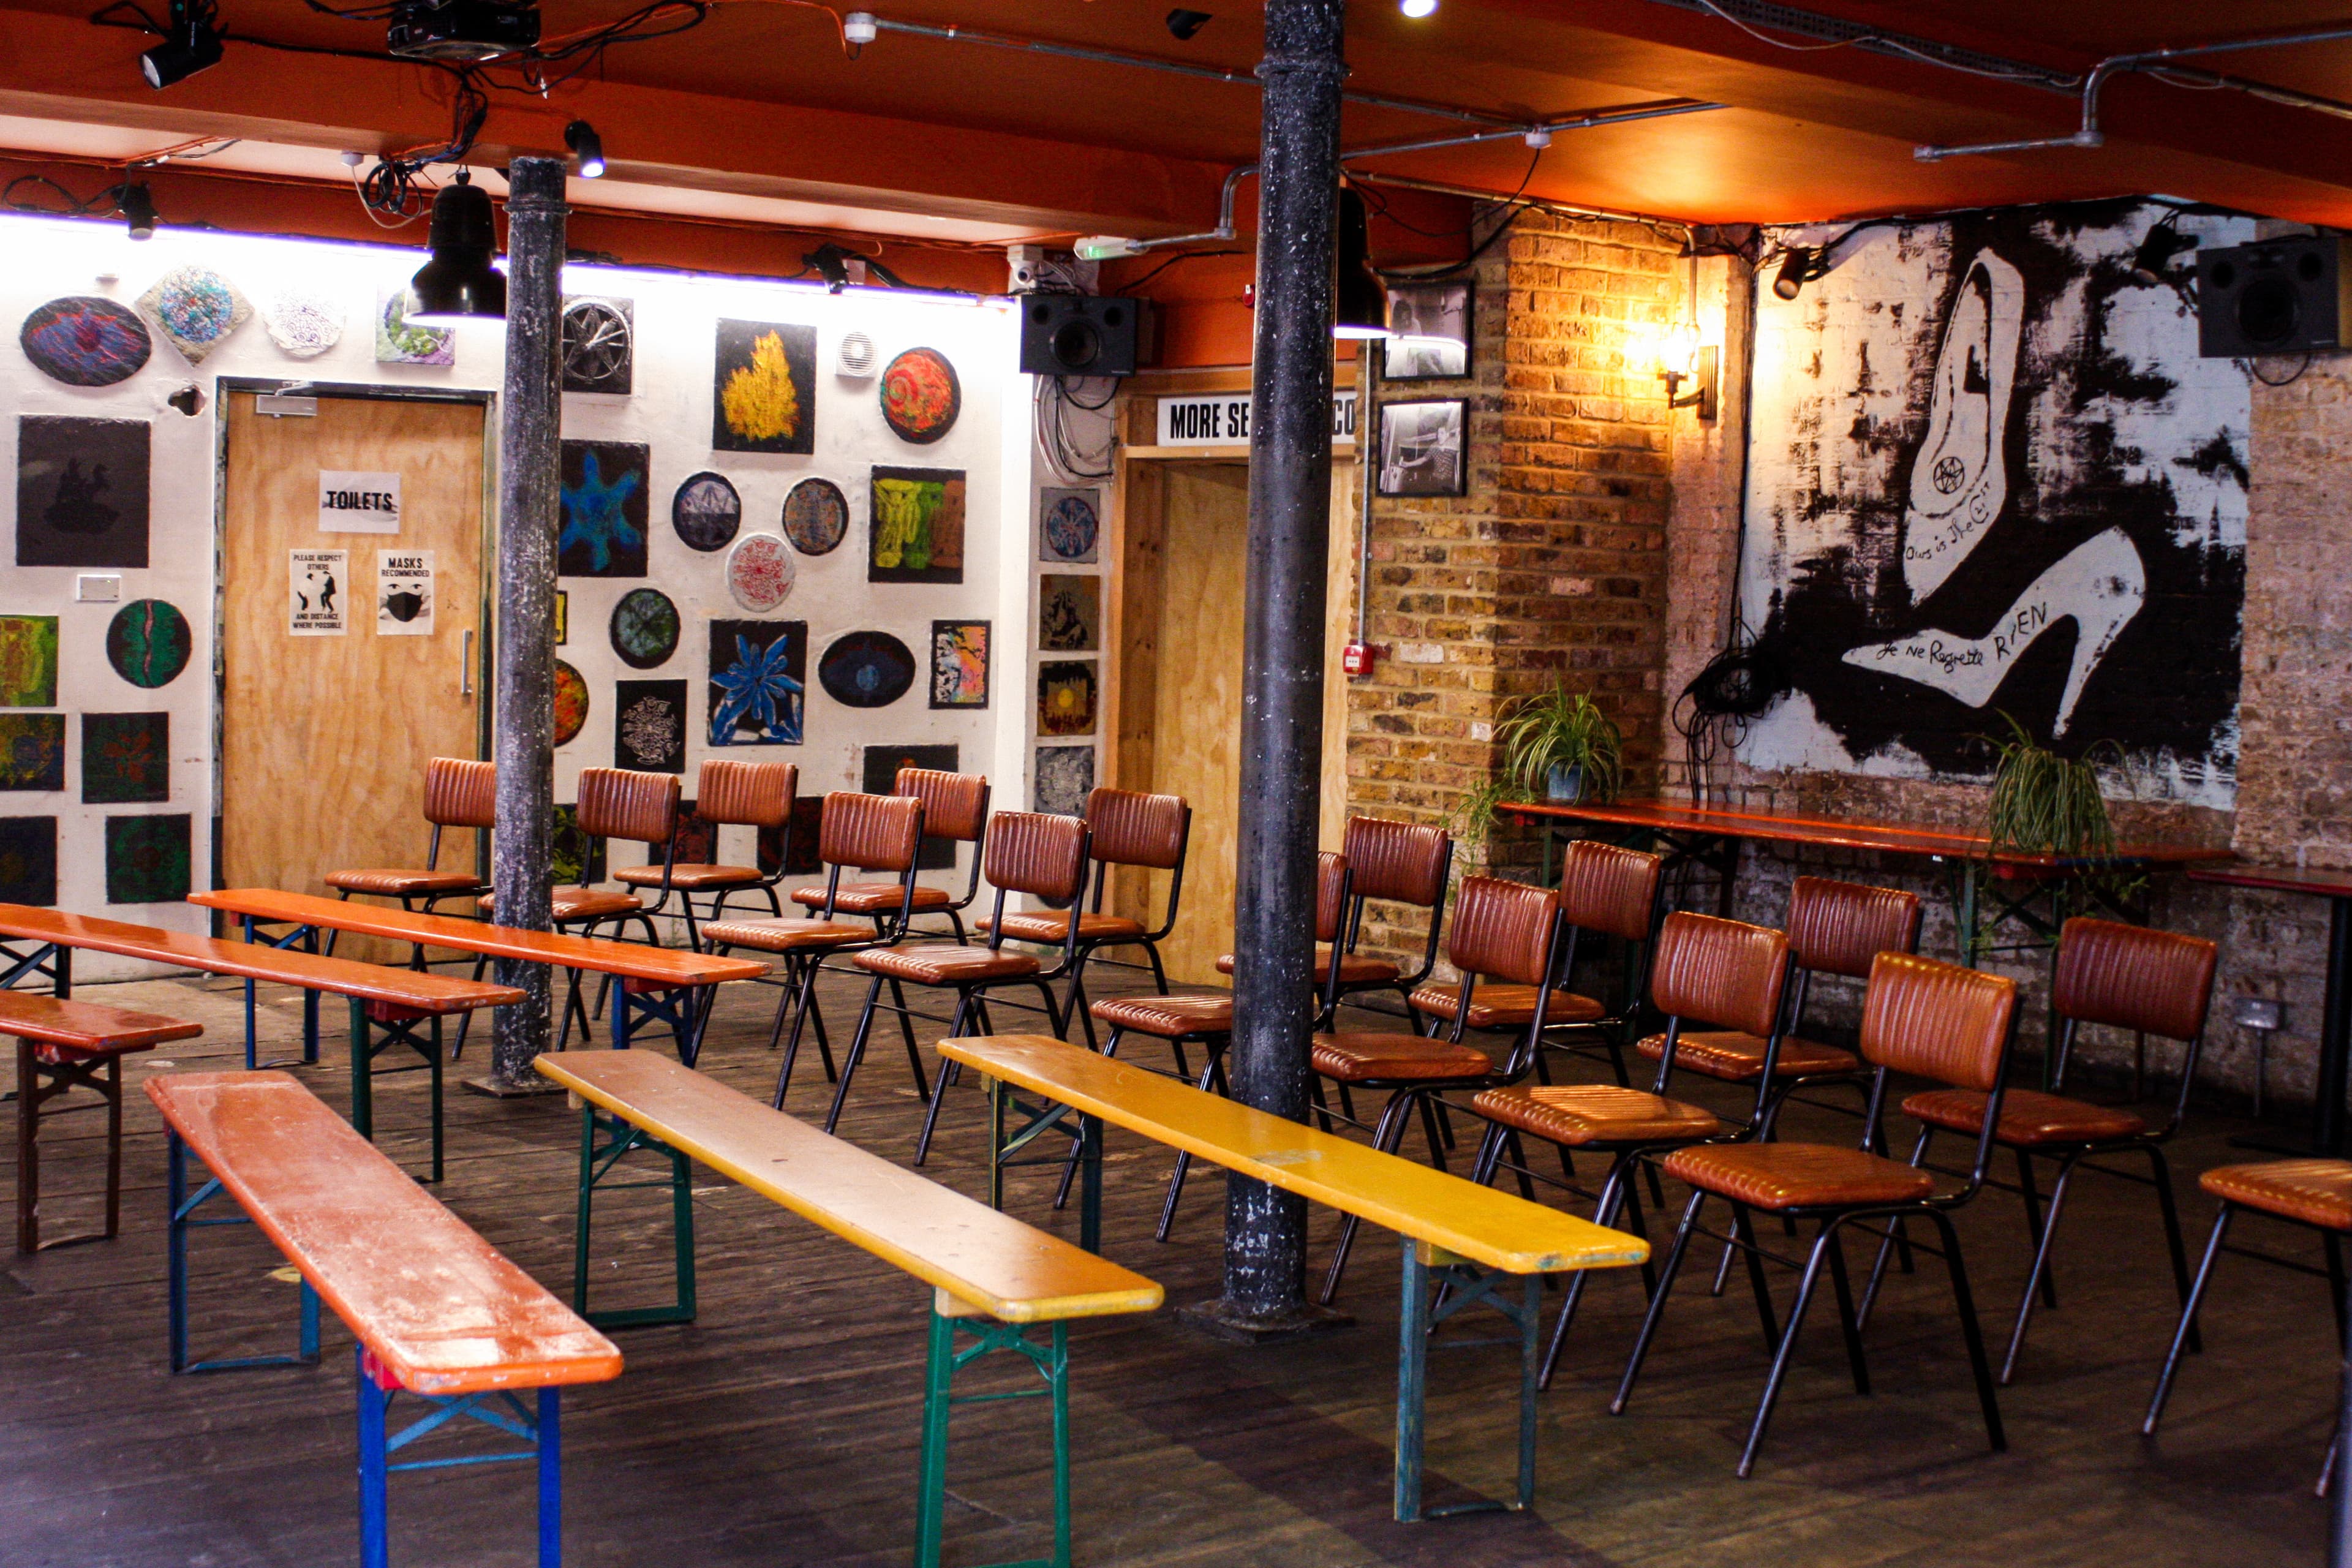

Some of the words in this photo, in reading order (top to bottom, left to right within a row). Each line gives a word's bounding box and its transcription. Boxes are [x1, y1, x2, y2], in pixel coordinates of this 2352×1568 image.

[1169, 403, 1221, 439] MORE
[1227, 402, 1250, 439] SE
[326, 491, 393, 511] TOILETS
[388, 557, 423, 568] MASKS
